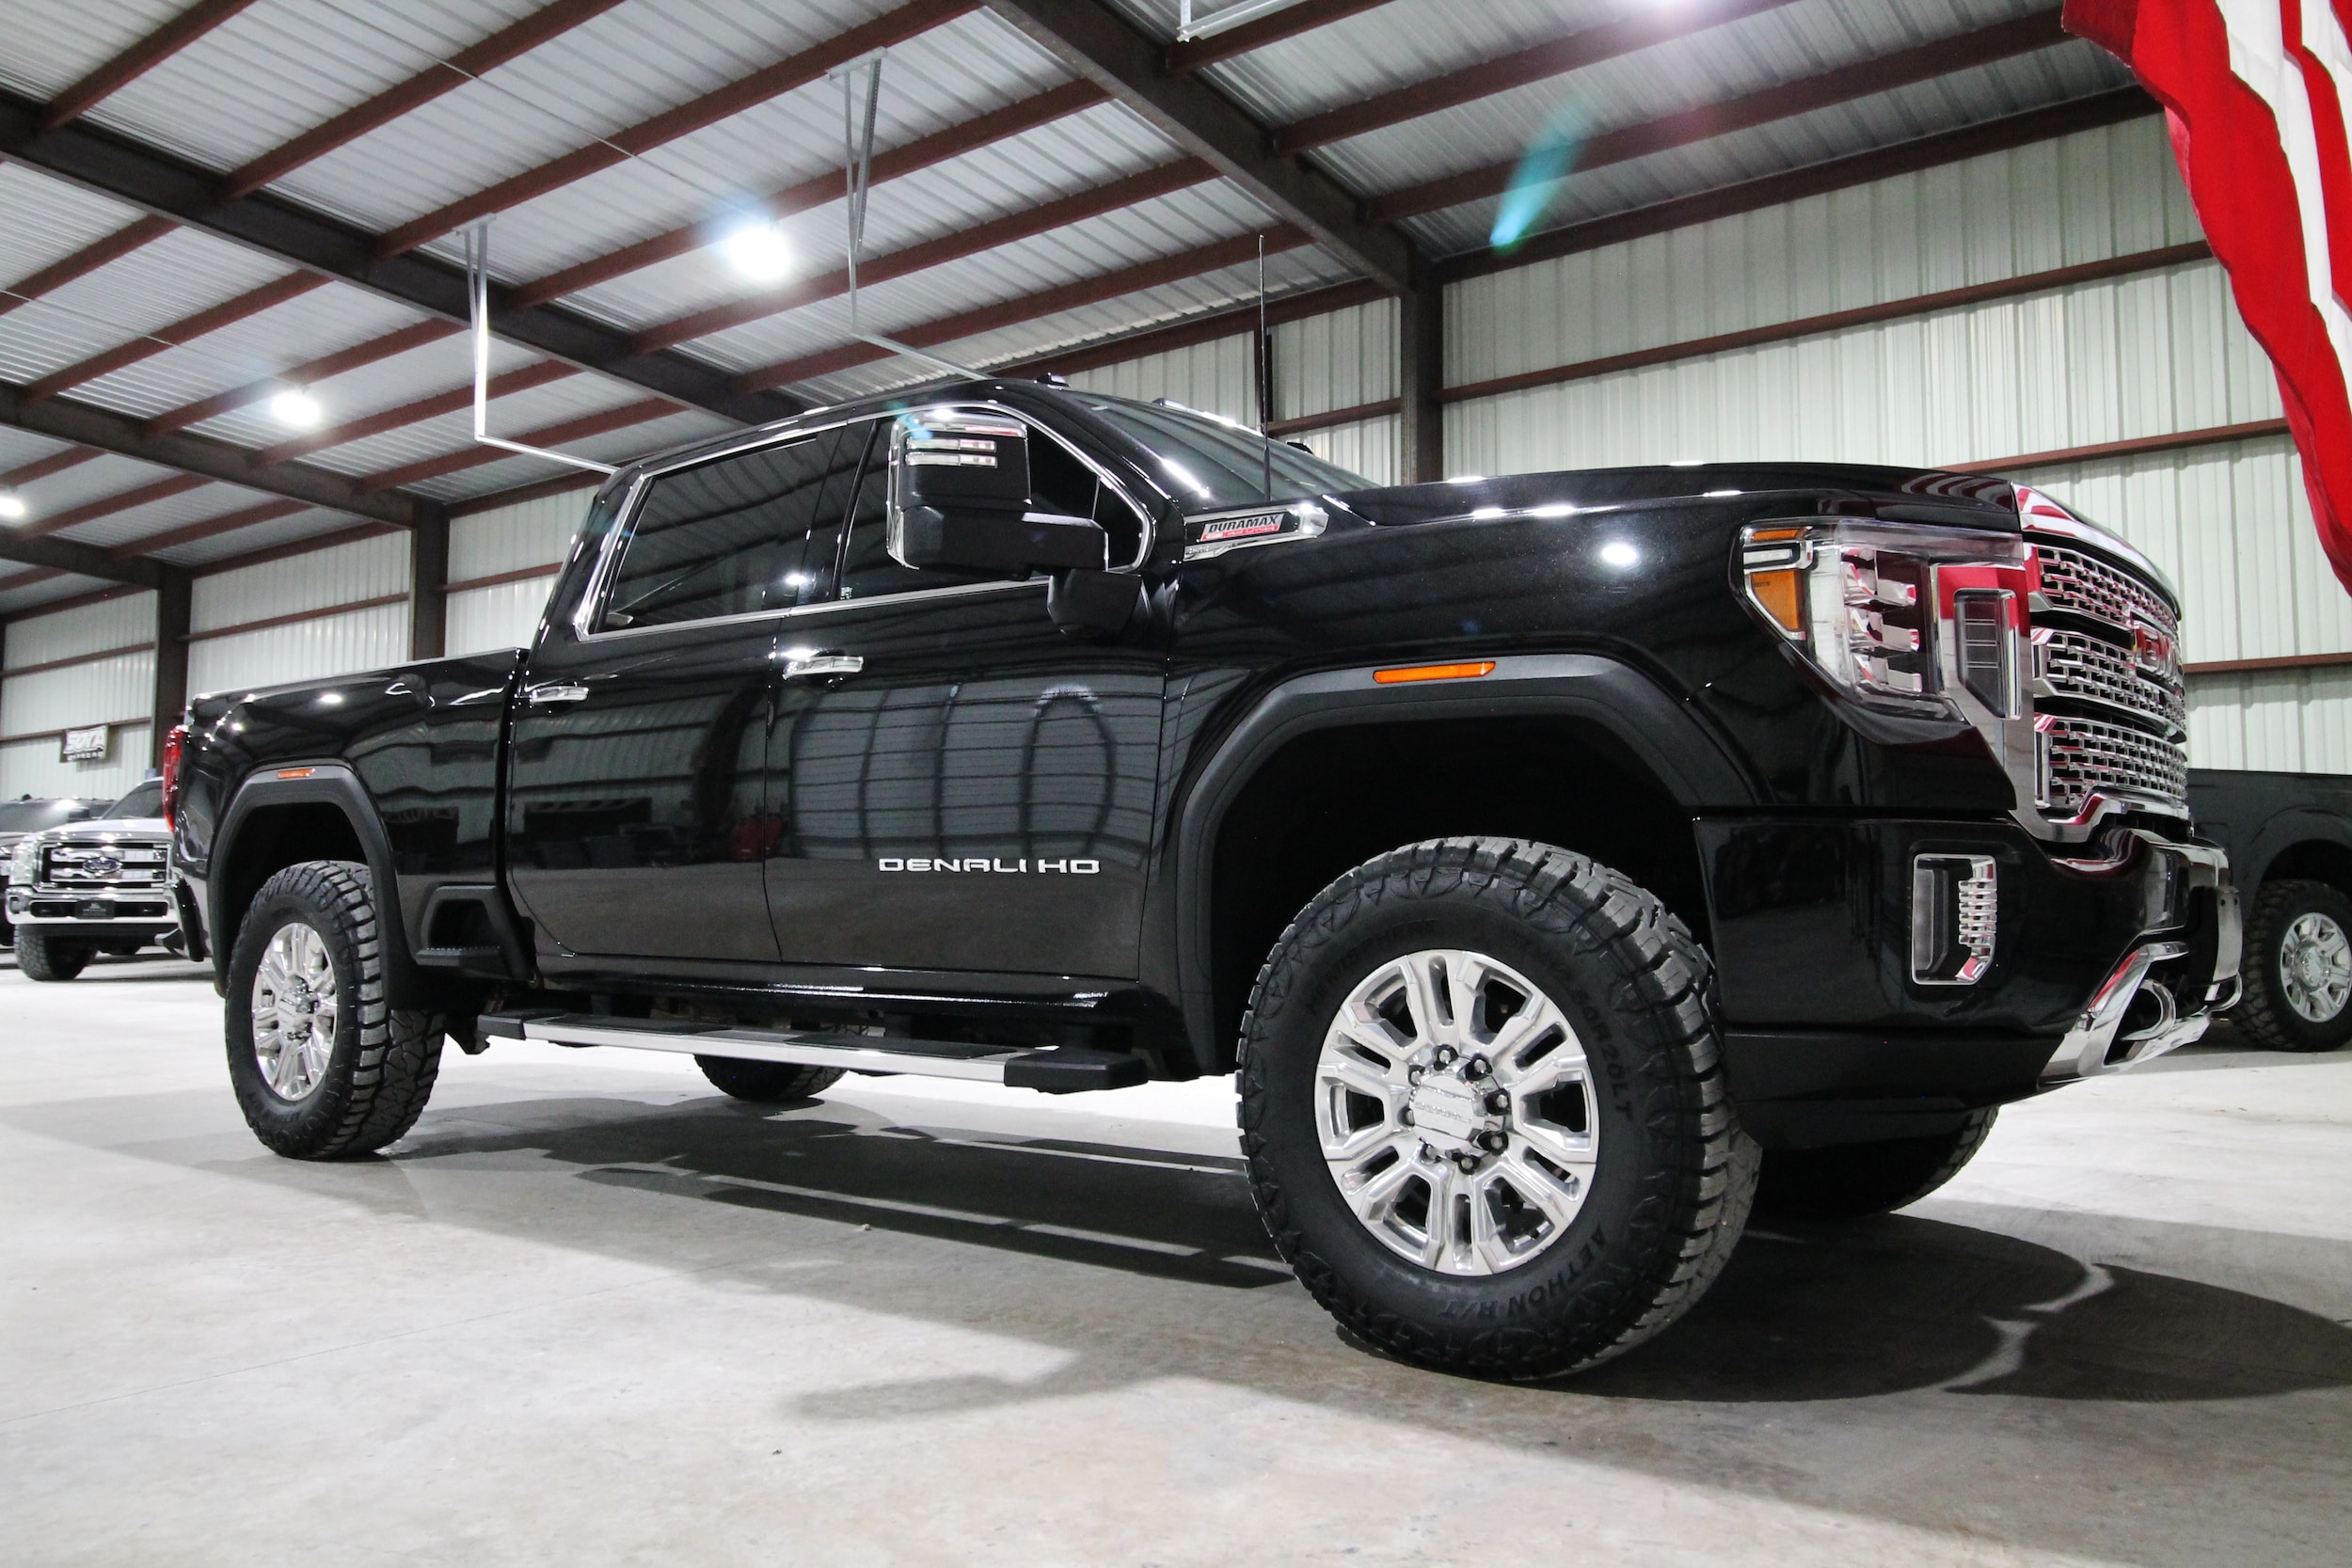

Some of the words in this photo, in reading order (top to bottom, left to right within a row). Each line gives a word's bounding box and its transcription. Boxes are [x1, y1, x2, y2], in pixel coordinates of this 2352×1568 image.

[1208, 515, 1279, 533] DURAMAX
[879, 857, 1027, 874] DENALI
[1038, 858, 1100, 875] HD
[1507, 1223, 1605, 1317] AETHON
[1438, 1299, 1498, 1321] R/T
